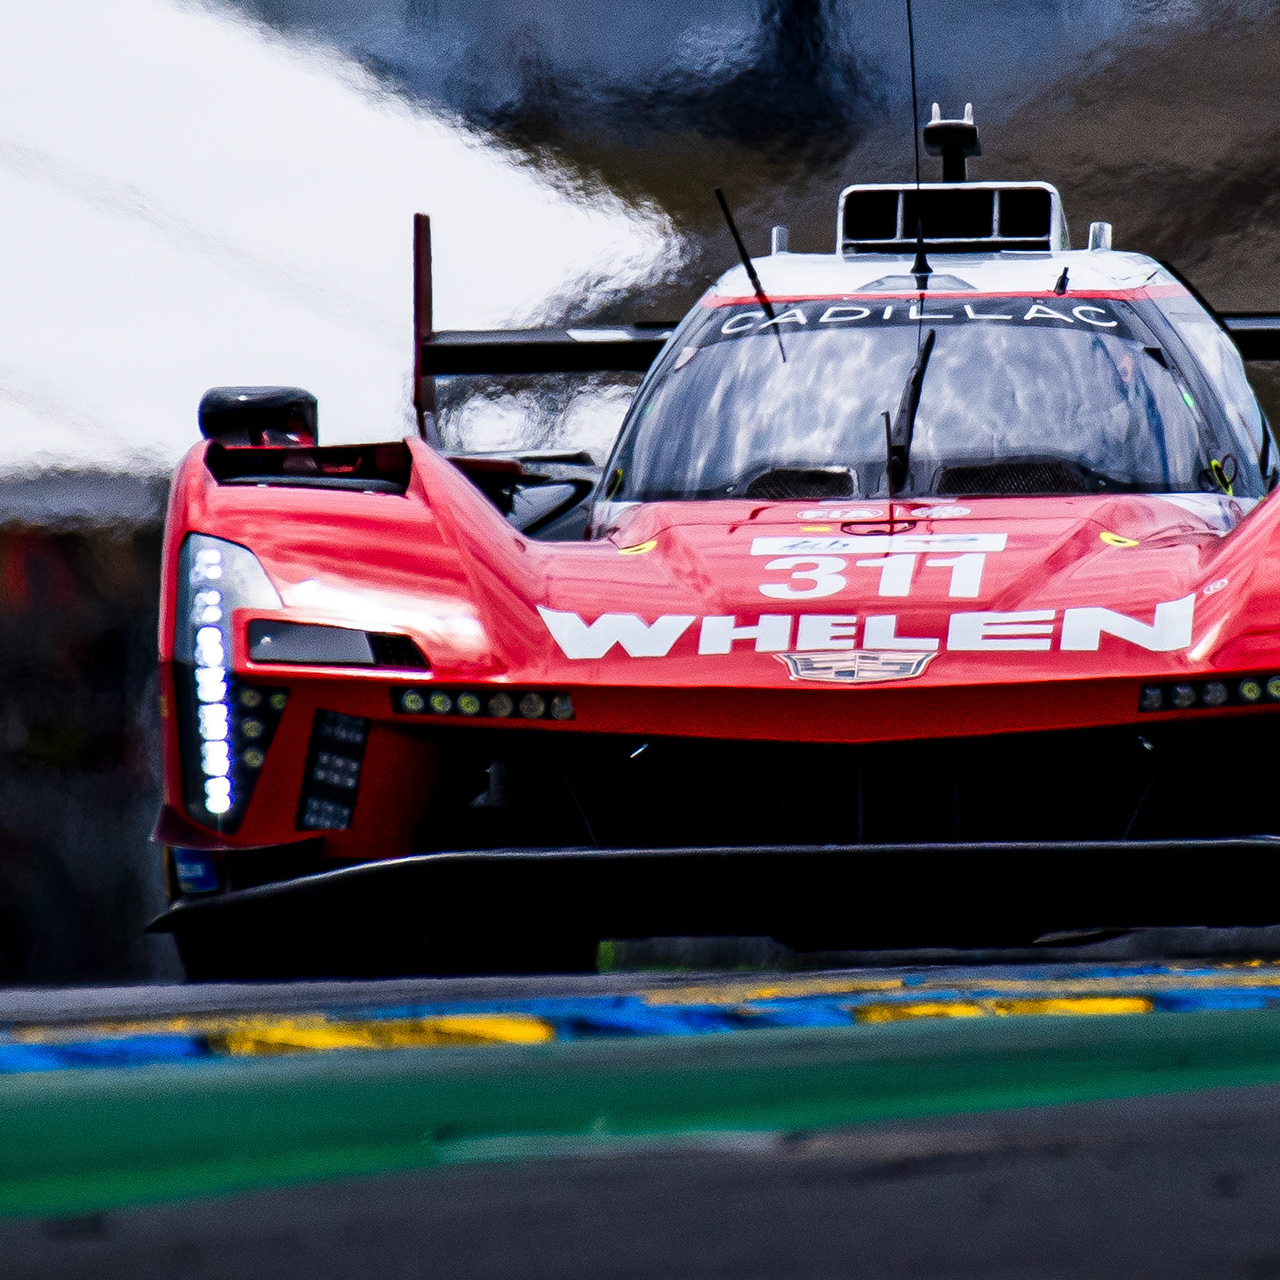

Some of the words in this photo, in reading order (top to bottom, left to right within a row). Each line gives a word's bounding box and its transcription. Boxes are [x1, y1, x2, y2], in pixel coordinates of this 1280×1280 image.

[720, 304, 1118, 335] CADILLAC
[802, 508, 873, 519] FIA
[757, 553, 987, 600] 311
[536, 593, 1197, 659] WHELEN
